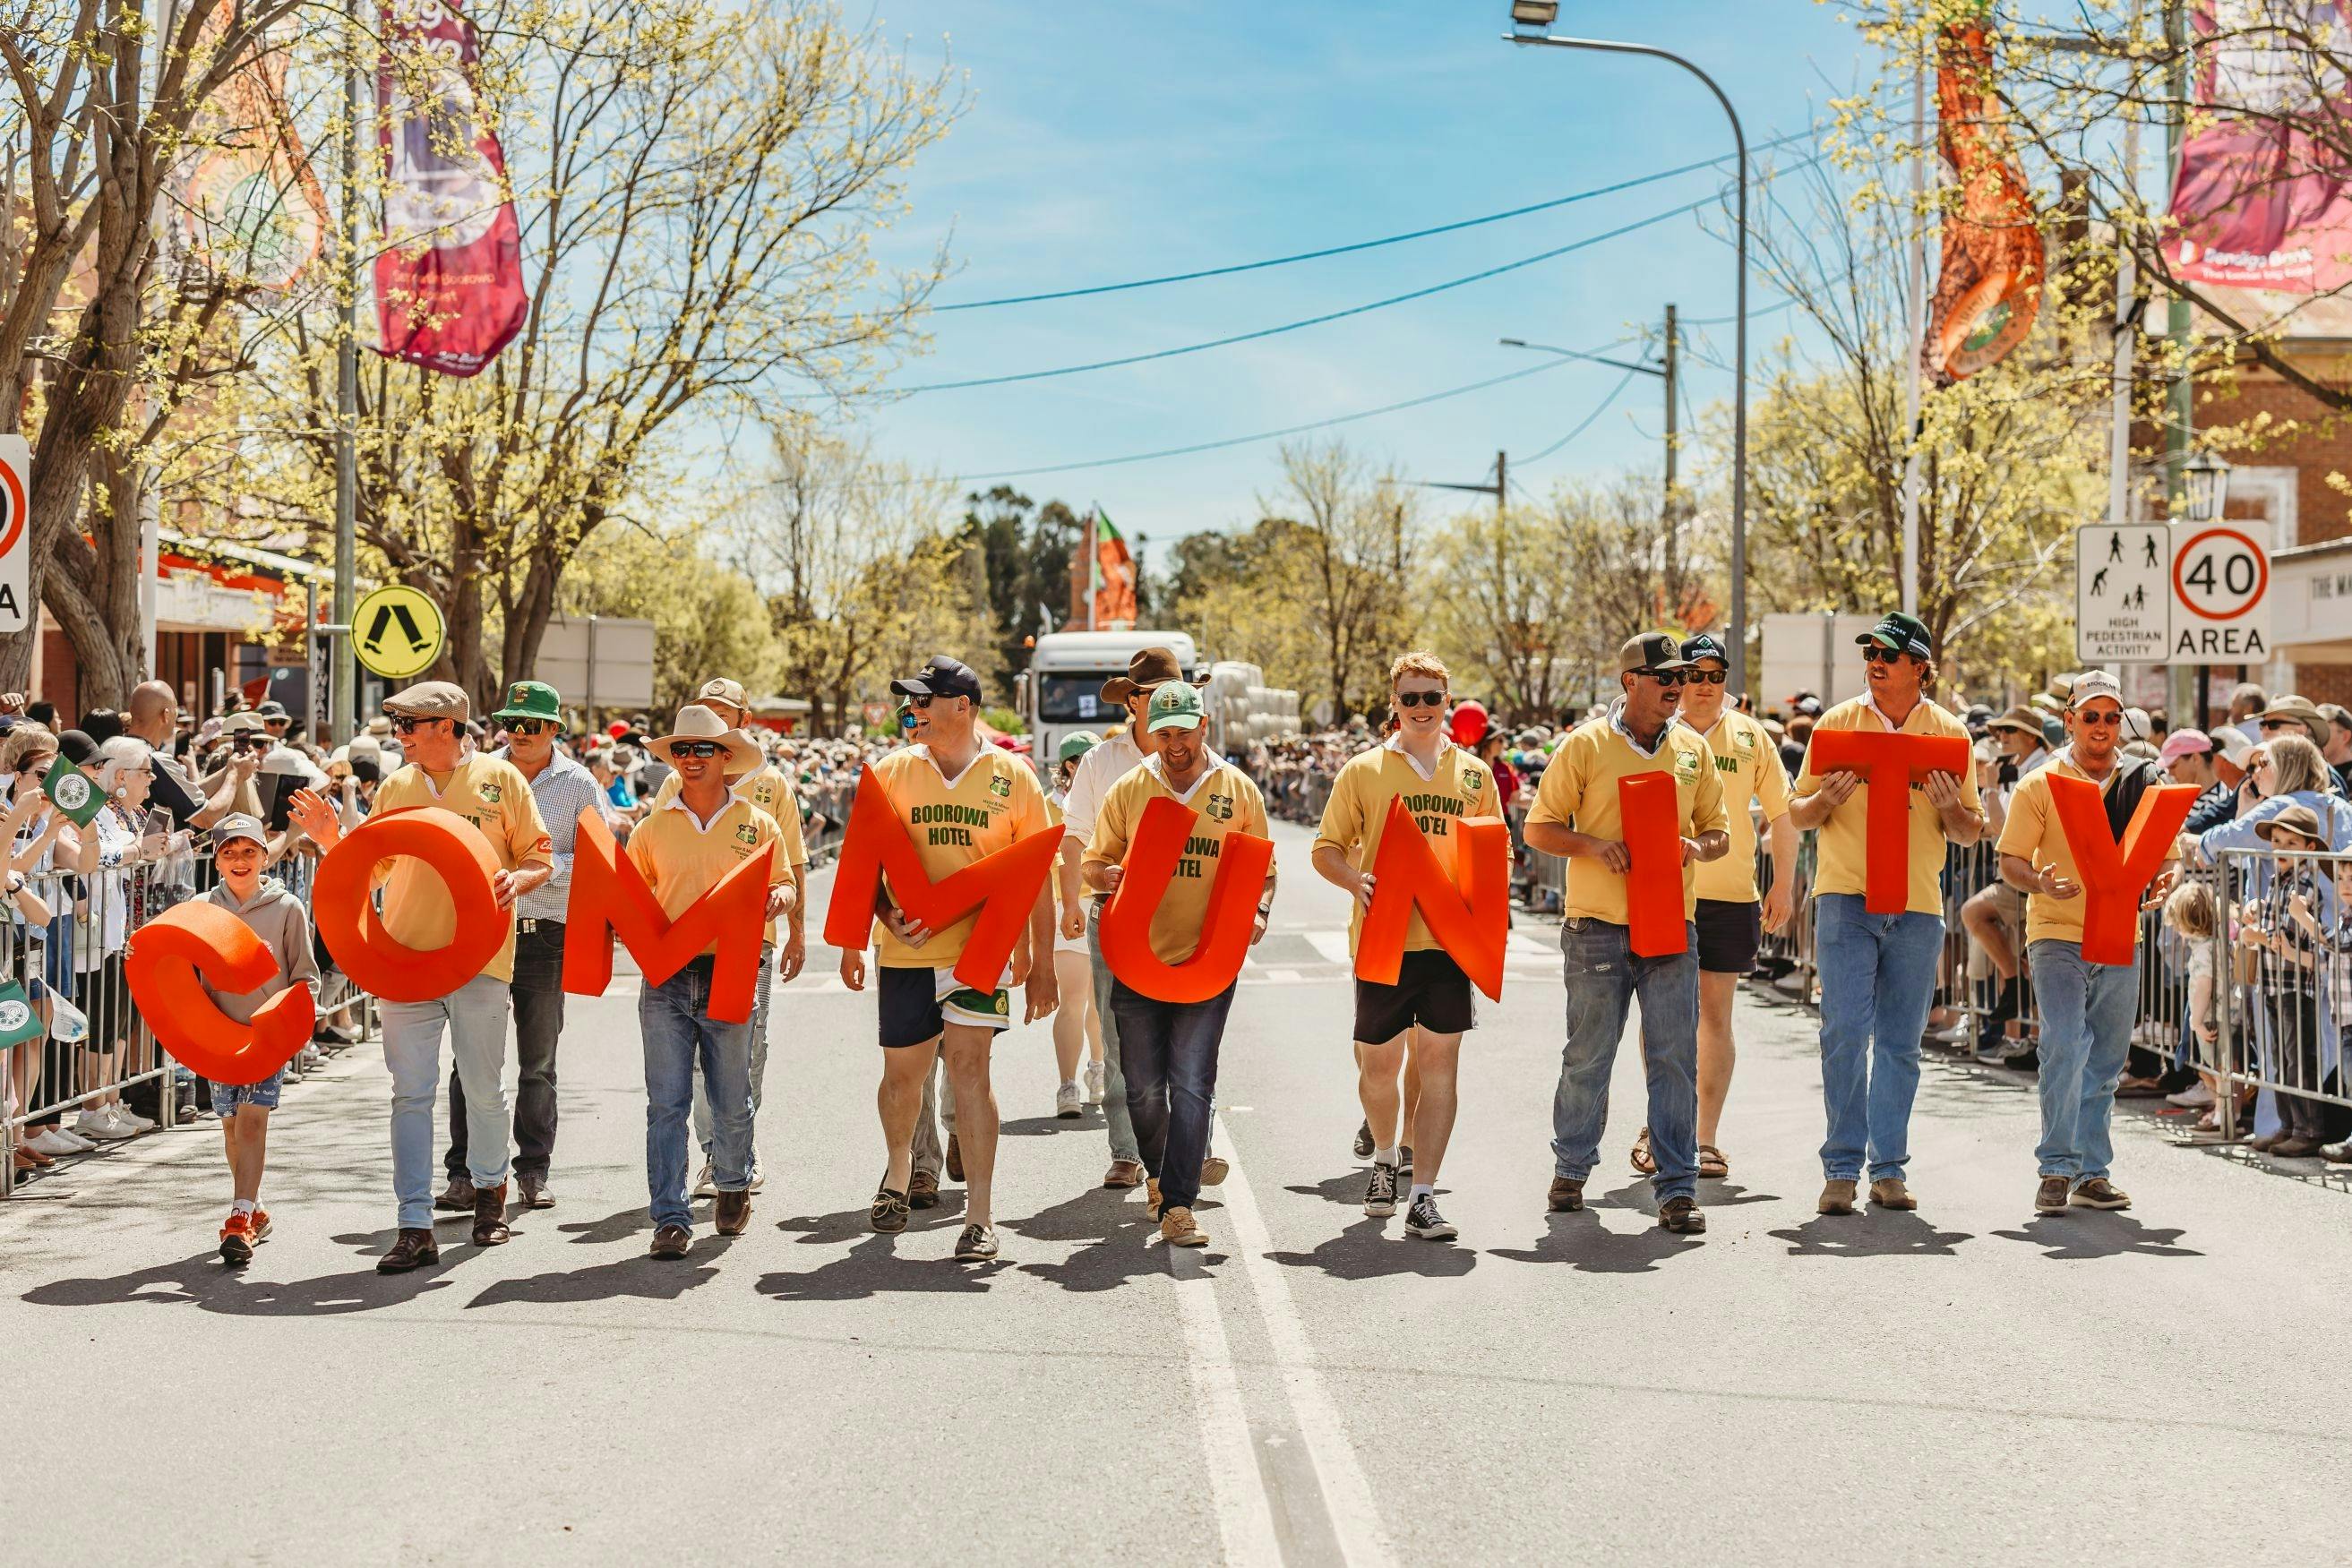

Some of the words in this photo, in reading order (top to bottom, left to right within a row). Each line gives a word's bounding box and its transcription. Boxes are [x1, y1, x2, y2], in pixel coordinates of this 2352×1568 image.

[2185, 553, 2254, 595] 40
[2108, 616, 2139, 629] HIGH
[2086, 630, 2162, 642] PEDESTRIAN
[2176, 628, 2264, 655] AREA
[2097, 644, 2150, 655] ACTIVITY
[911, 803, 989, 829] BOOROWA
[928, 827, 973, 847] HOTEL
